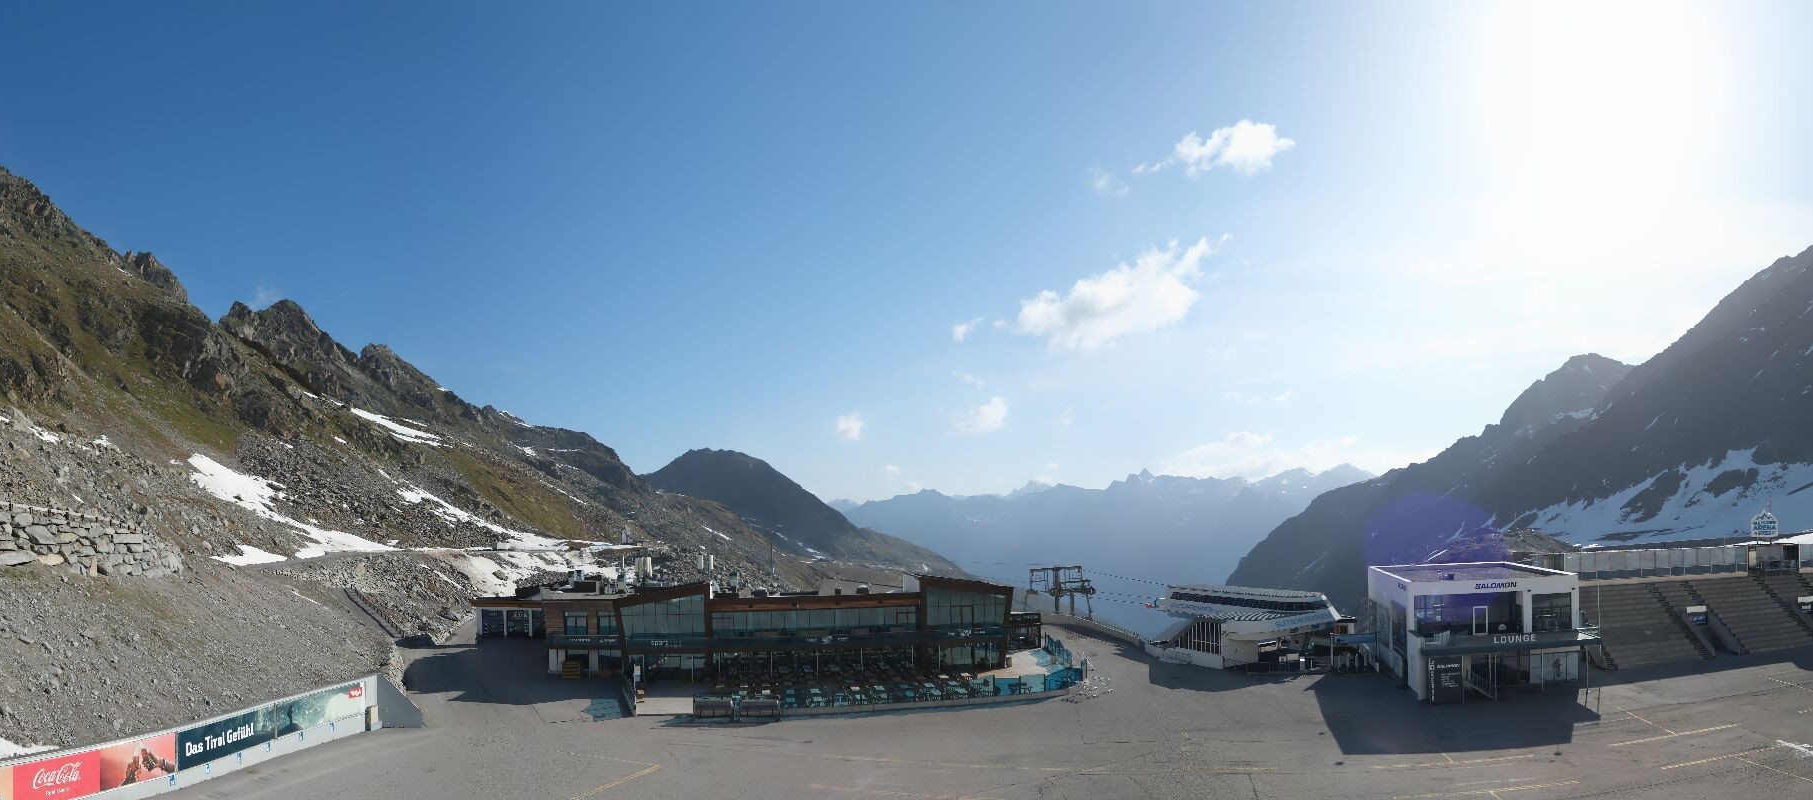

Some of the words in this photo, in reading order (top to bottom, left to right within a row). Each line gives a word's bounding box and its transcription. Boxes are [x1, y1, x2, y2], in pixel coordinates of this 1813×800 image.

[1474, 581, 1517, 590] SALOMON
[1493, 633, 1537, 644] LOUNGE
[185, 741, 204, 757] Das
[204, 731, 226, 751] Tirol
[226, 722, 255, 744] Gefühl
